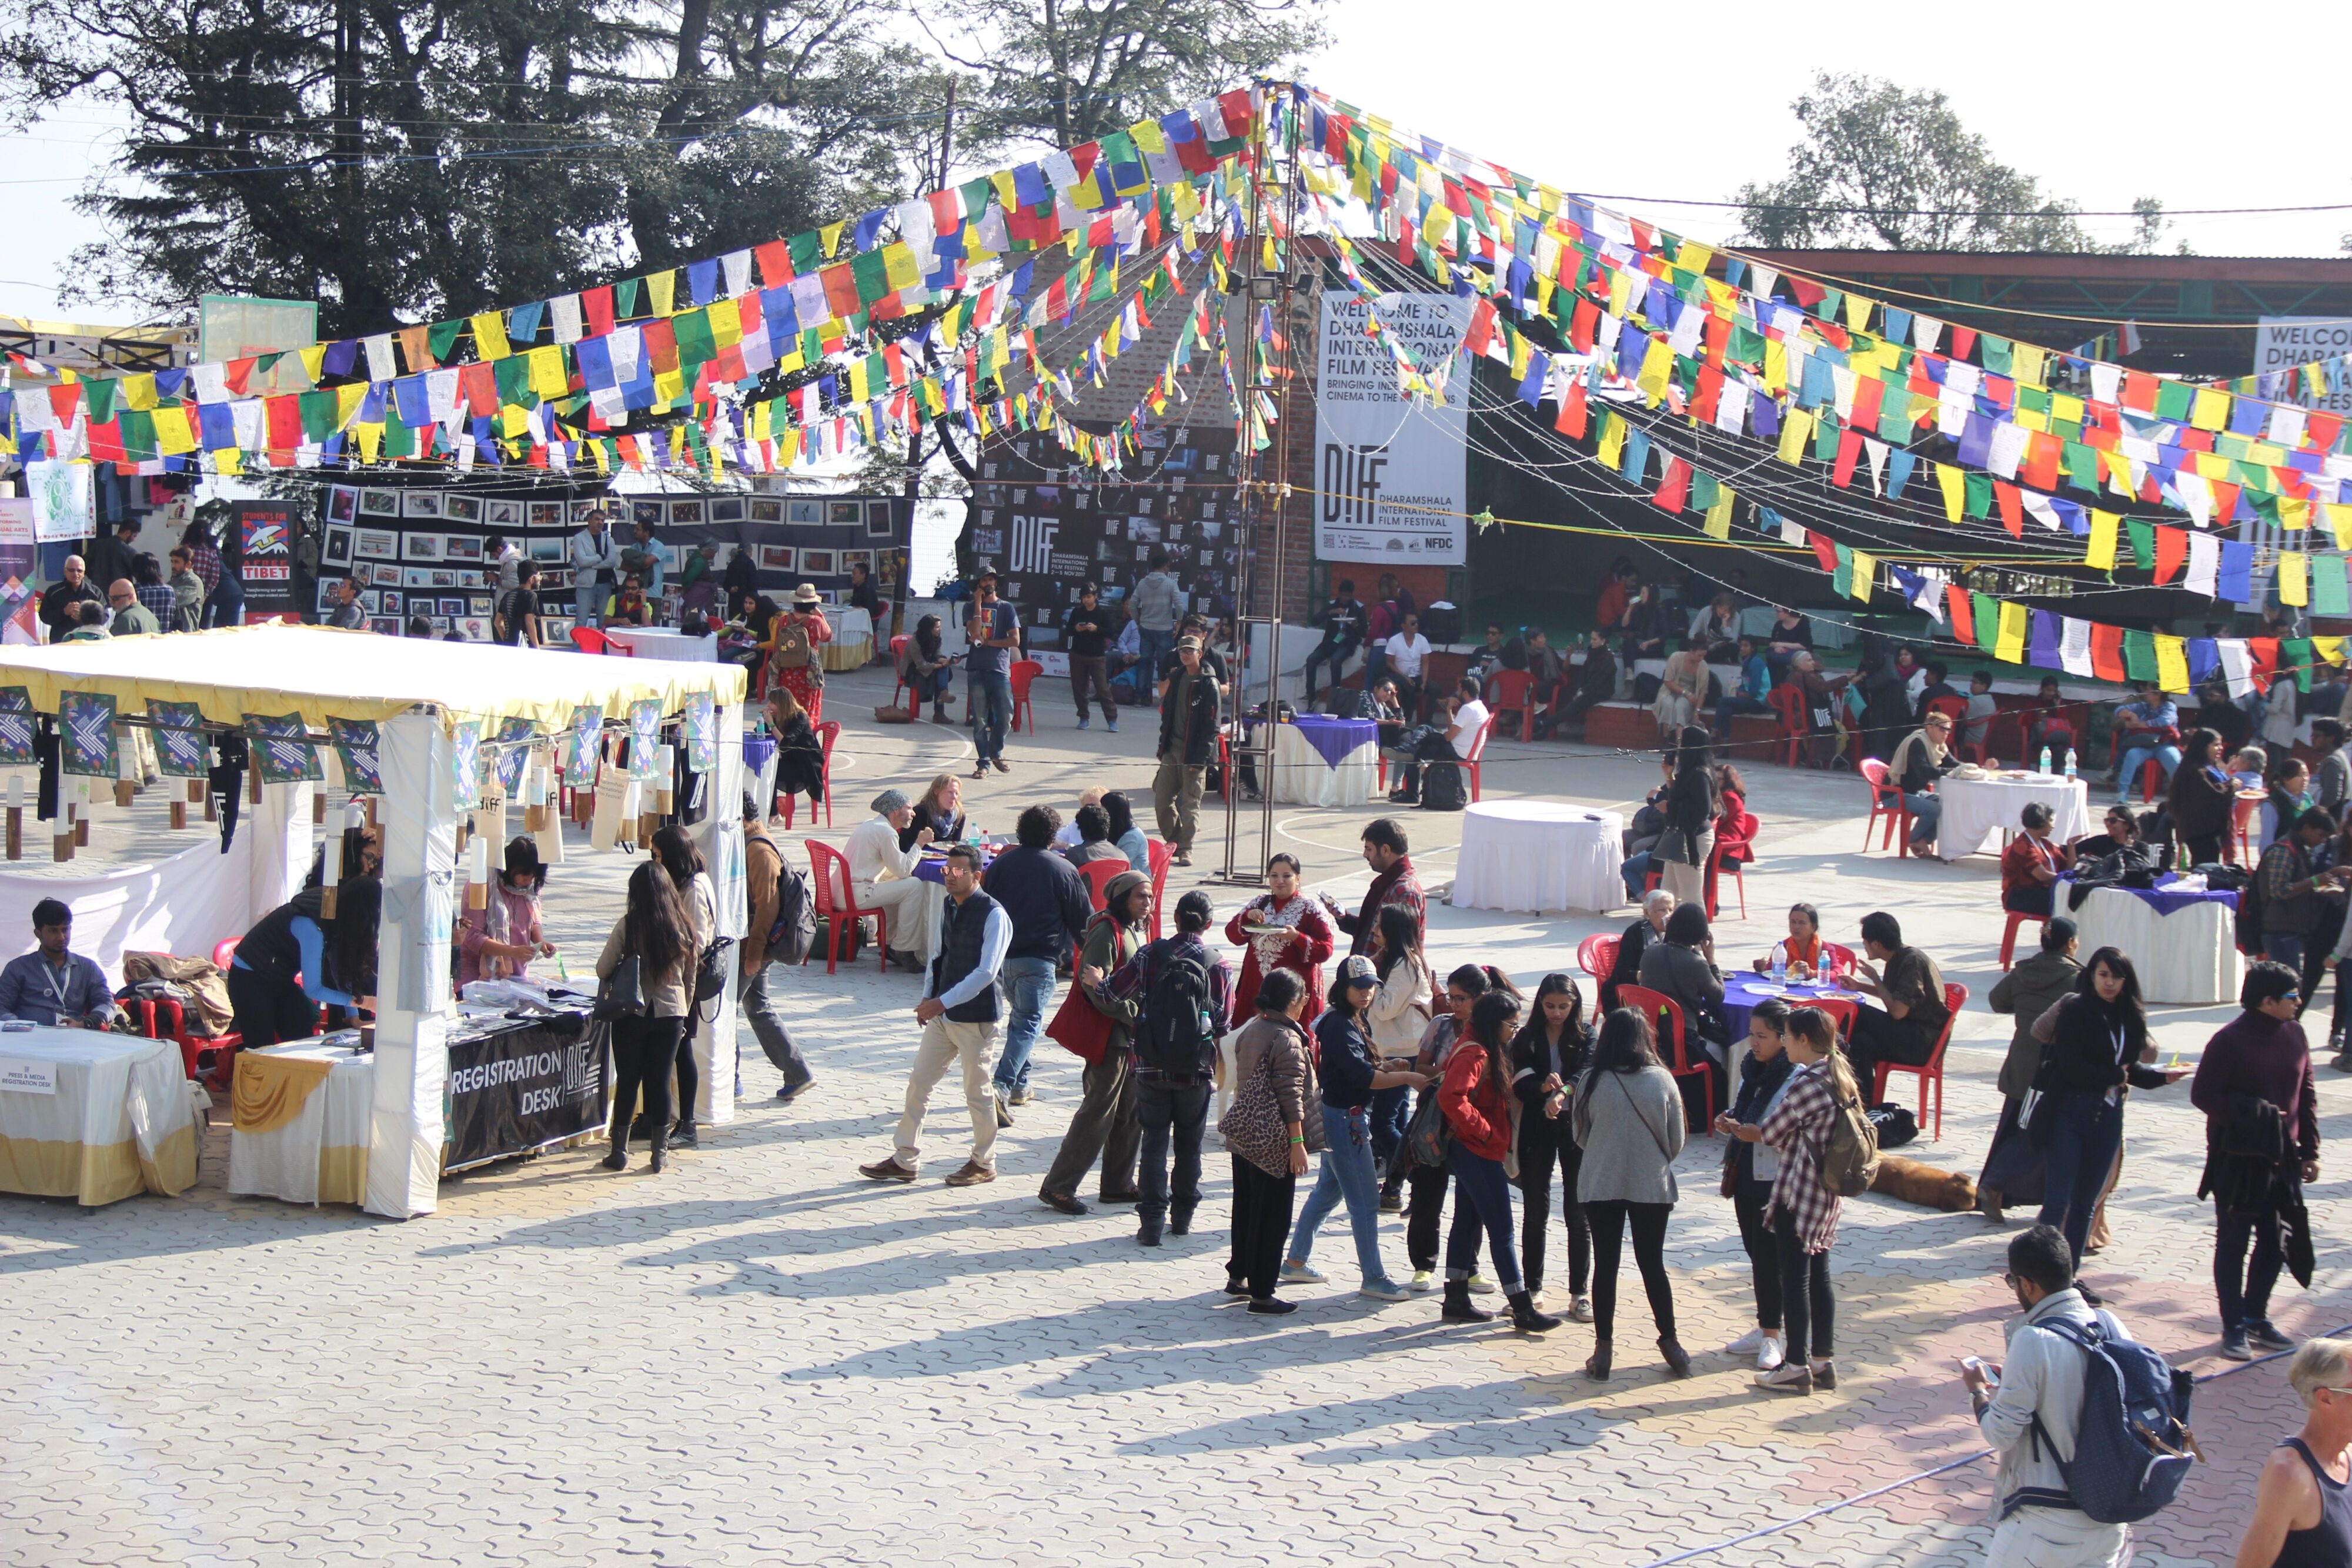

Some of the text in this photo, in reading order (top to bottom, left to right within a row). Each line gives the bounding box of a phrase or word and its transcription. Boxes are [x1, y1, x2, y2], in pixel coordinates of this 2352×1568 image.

[2271, 327, 2352, 346] WELCO
[1327, 359, 1366, 376] FILM
[1327, 379, 1375, 390] BRINGING
[1327, 392, 1364, 402] CINEMA
[1367, 393, 1381, 402] TO
[1383, 393, 1398, 402] THE
[1379, 494, 1452, 506] DHARAMSHALA
[242, 512, 288, 521] STUDENTS FOR
[1379, 516, 1447, 527] FILM FESTIVAL
[1425, 537, 1453, 549] NFDC
[244, 567, 289, 579] TIBET
[452, 1049, 562, 1095] REGISTRATION
[2, 1078, 38, 1086] REGISTRATION
[521, 1086, 562, 1116] DESK
